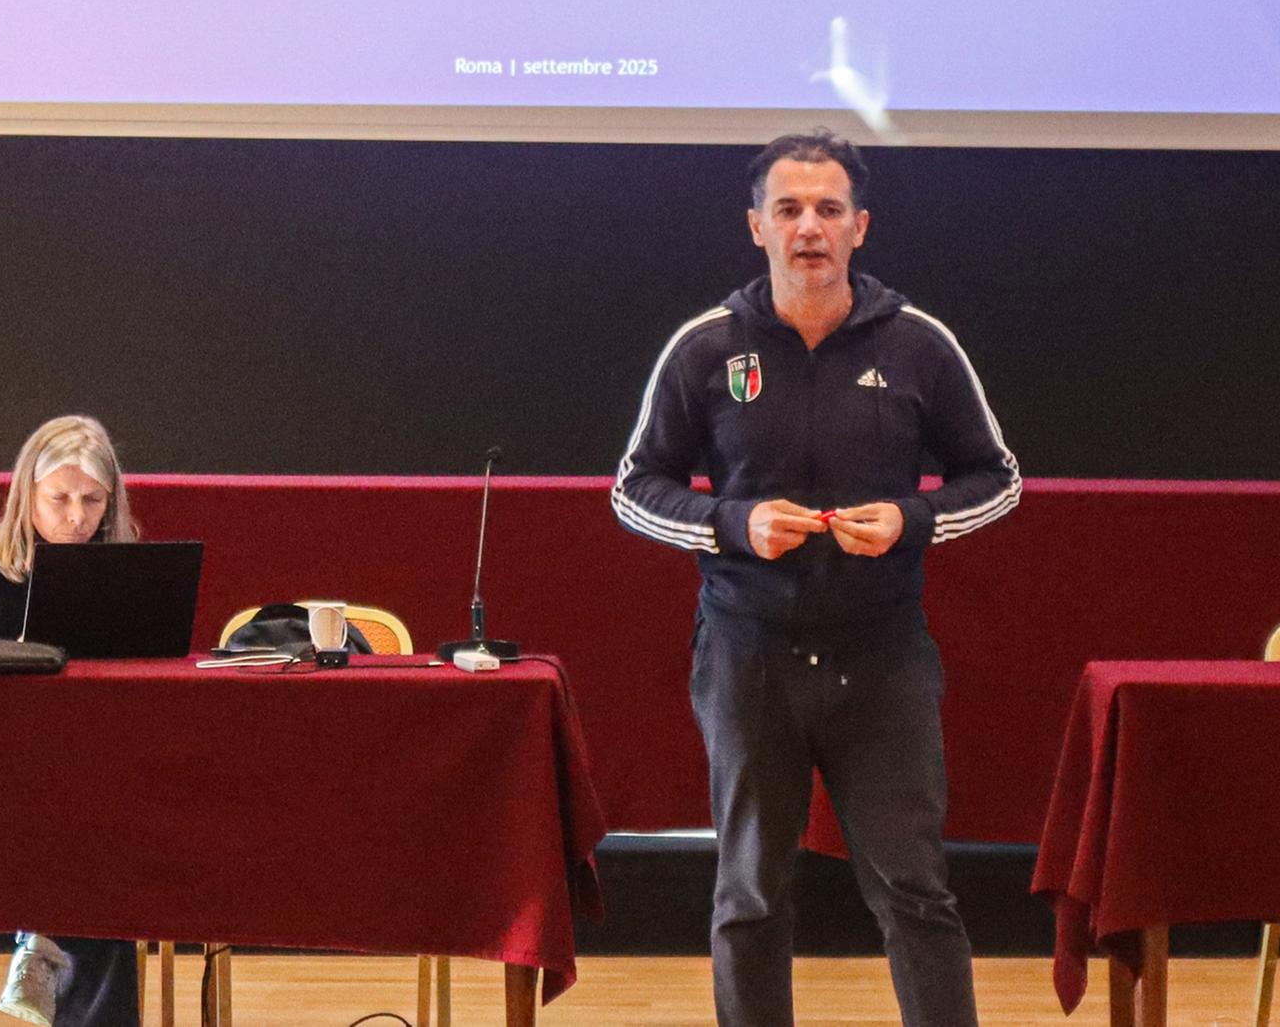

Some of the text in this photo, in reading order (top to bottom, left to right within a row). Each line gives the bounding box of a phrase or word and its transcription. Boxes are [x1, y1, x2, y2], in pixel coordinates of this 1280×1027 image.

[455, 57, 502, 74] Roma
[523, 58, 613, 75] settembre
[618, 59, 658, 75] 2025
